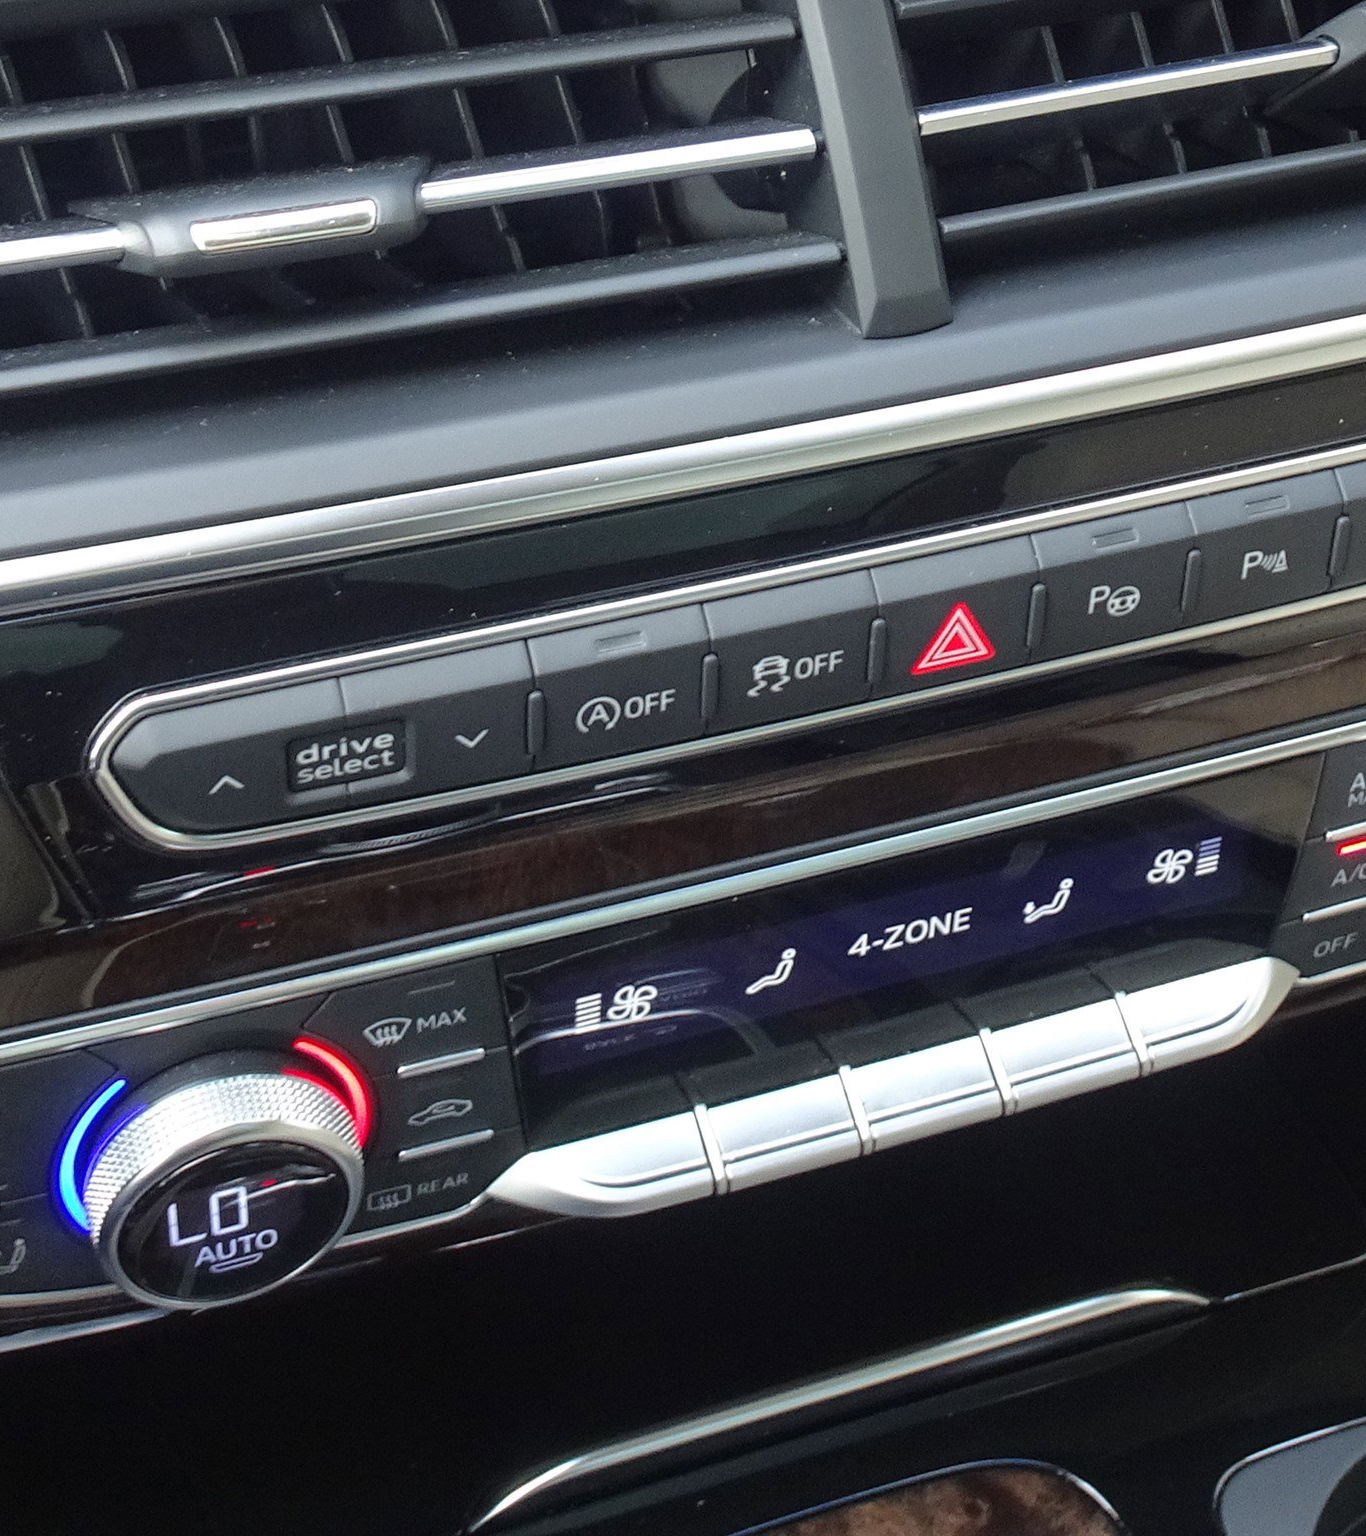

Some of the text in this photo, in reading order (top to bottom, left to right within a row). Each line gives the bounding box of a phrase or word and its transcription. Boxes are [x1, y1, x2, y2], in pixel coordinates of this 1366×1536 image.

[794, 650, 844, 681] OFF
[623, 689, 676, 720] OFF
[296, 730, 395, 767] drive
[296, 750, 395, 785] select
[846, 906, 974, 959] 4-ZONE
[1313, 930, 1359, 958] OFF
[415, 1006, 467, 1035] MAX
[416, 1172, 469, 1196] REAR
[194, 1228, 279, 1268] AUTO
